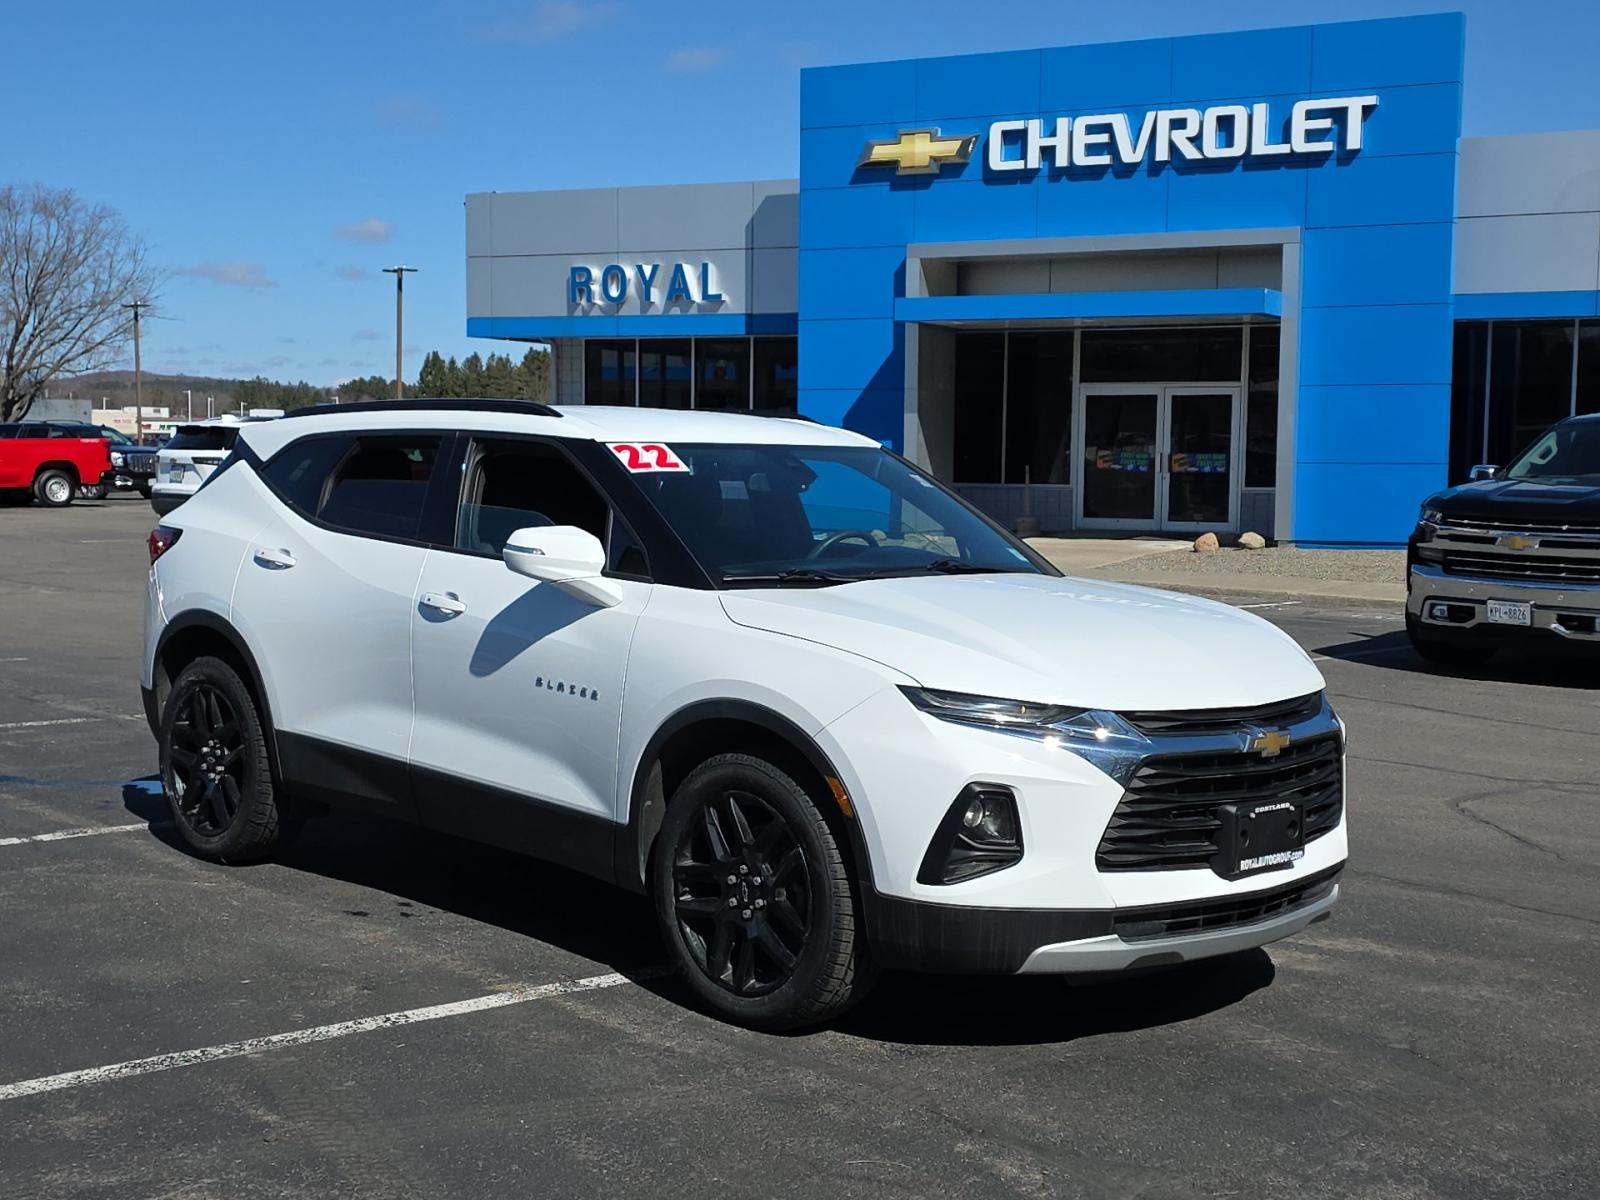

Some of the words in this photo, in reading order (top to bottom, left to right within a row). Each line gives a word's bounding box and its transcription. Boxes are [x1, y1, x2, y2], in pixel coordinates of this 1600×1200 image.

[989, 95, 1379, 171] CHEVROLET
[570, 262, 723, 304] ROYAL
[613, 444, 680, 469] 22
[535, 676, 598, 701] BLAZER
